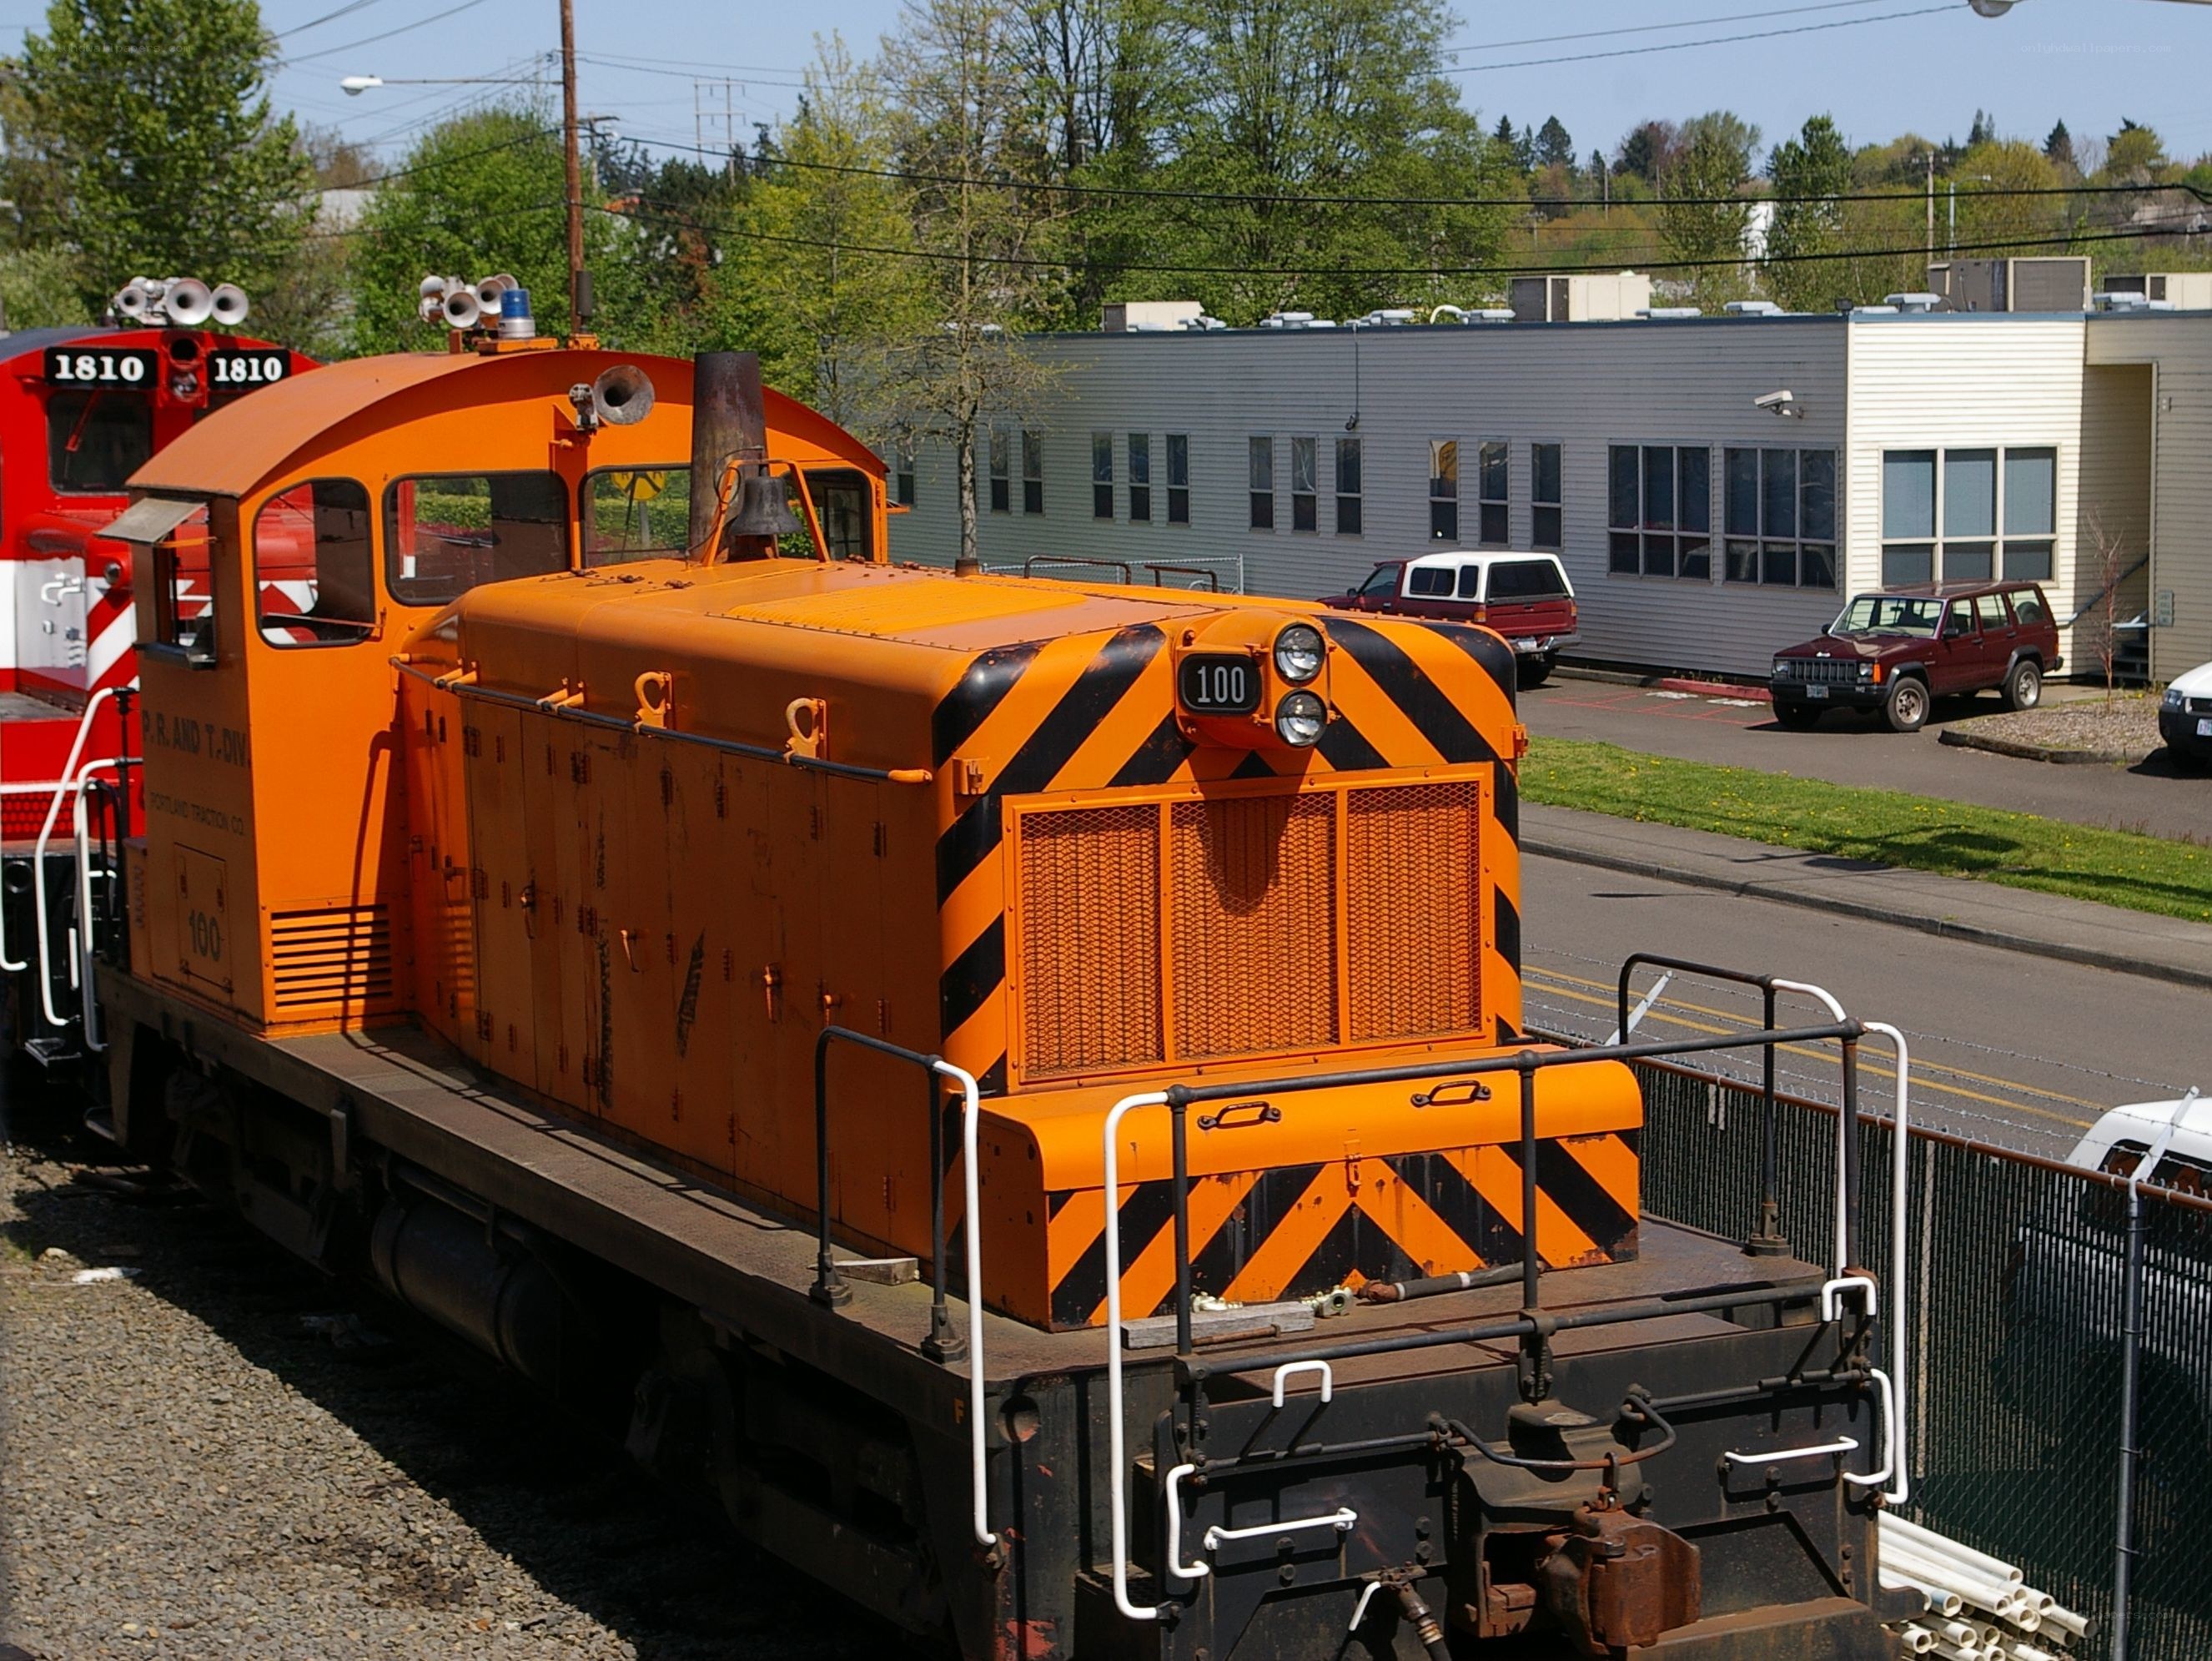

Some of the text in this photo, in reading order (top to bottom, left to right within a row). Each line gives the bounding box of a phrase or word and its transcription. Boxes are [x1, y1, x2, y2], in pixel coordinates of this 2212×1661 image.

[53, 354, 144, 382] 1810
[214, 355, 283, 383] 1810
[1197, 665, 1245, 703] 100
[173, 716, 200, 753] AND
[150, 791, 188, 818] PORTLAND
[191, 803, 229, 832] TRACTION
[189, 909, 220, 962] 100
[953, 1397, 965, 1425] F
